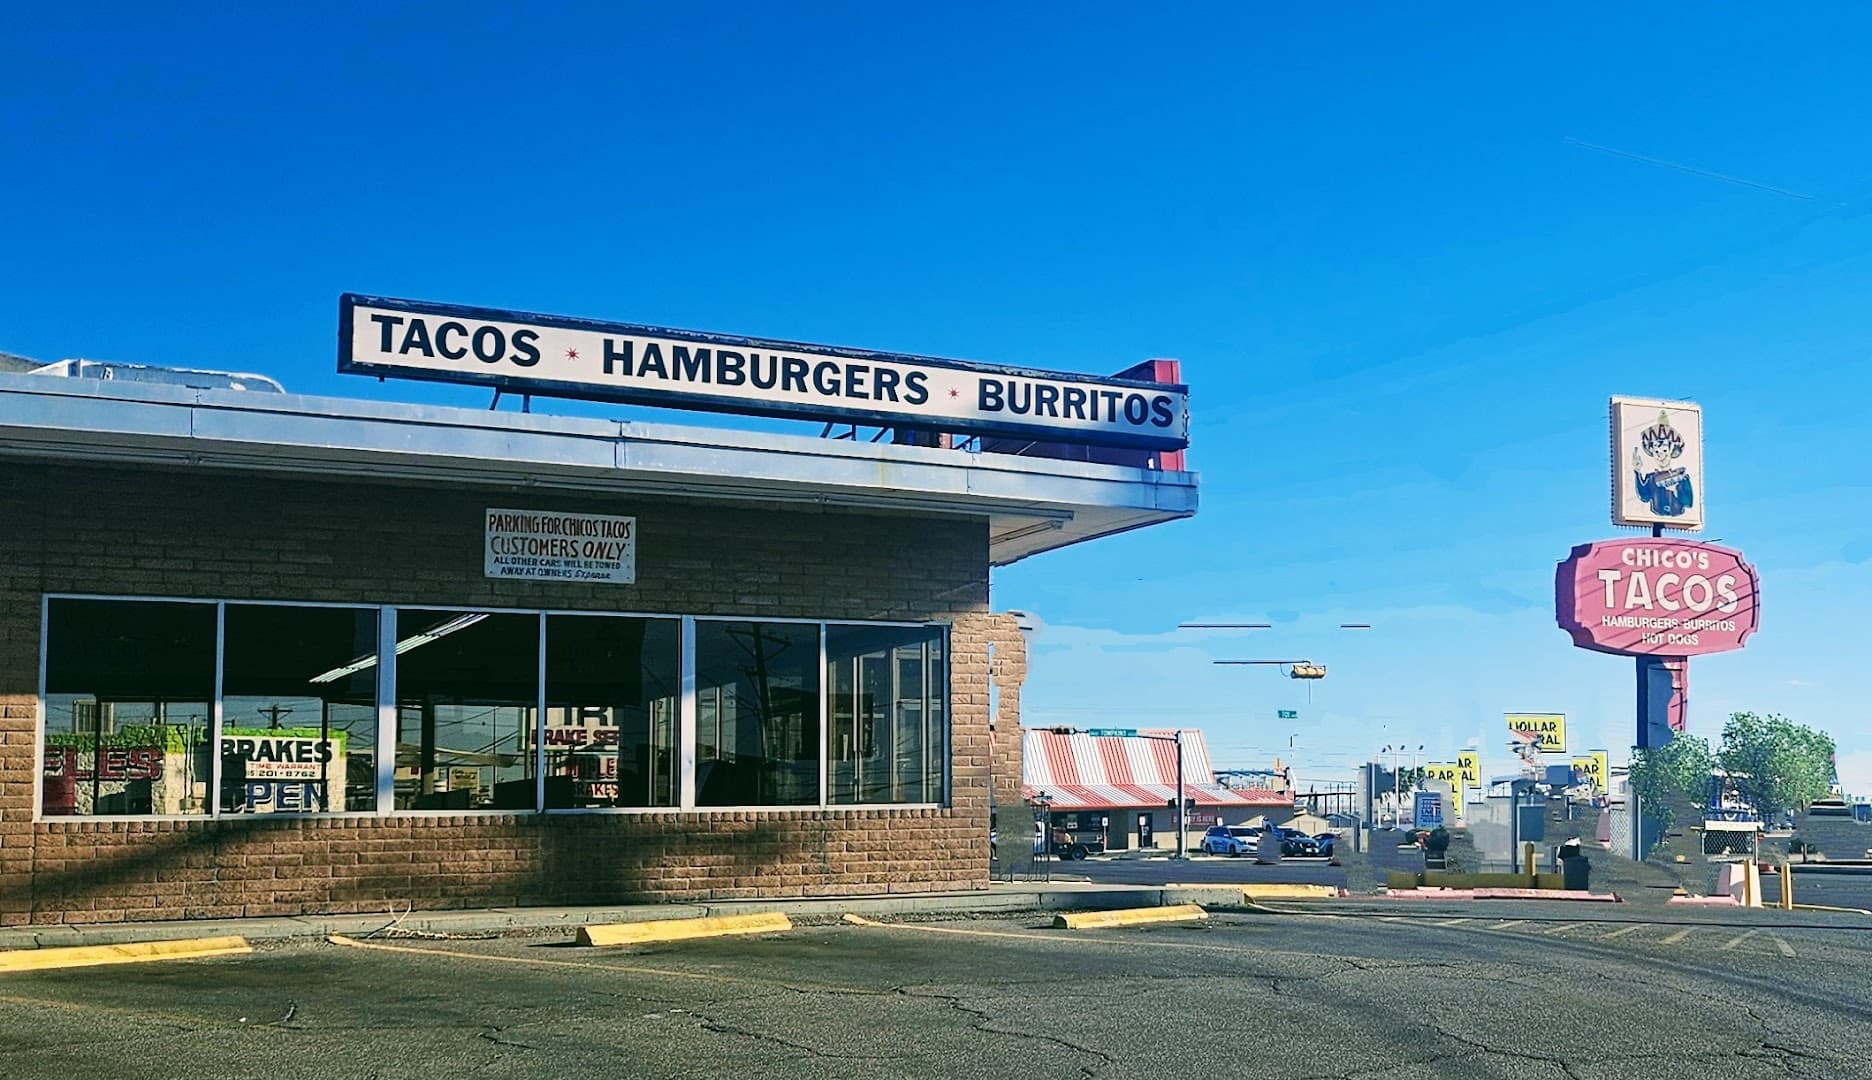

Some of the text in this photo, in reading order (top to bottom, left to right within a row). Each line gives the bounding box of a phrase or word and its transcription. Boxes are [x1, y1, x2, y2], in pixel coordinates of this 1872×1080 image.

[371, 314, 1173, 427] TACOS HAMBURGERS BURRITOS
[489, 514, 540, 533] PARKING
[600, 519, 631, 539] TACOS
[491, 536, 626, 560] CUSTOMERS ONLY
[1622, 547, 1709, 569] CHICO'S
[494, 556, 509, 565] ALL
[511, 557, 537, 567] OTHER
[540, 558, 561, 568] CARS
[563, 559, 582, 569] WILL
[595, 561, 621, 570] TOWED
[501, 566, 525, 576] AWAY
[525, 567, 536, 576] AT
[538, 567, 572, 578] OWNERS
[1598, 568, 1738, 613] TACOS
[1602, 615, 1736, 631] HAMBURGERS BURRITOS
[1642, 633, 1699, 646] HOT DOGS
[531, 729, 587, 745] BRAKE
[221, 739, 332, 763] BRAKES
[221, 783, 327, 811] PEN
